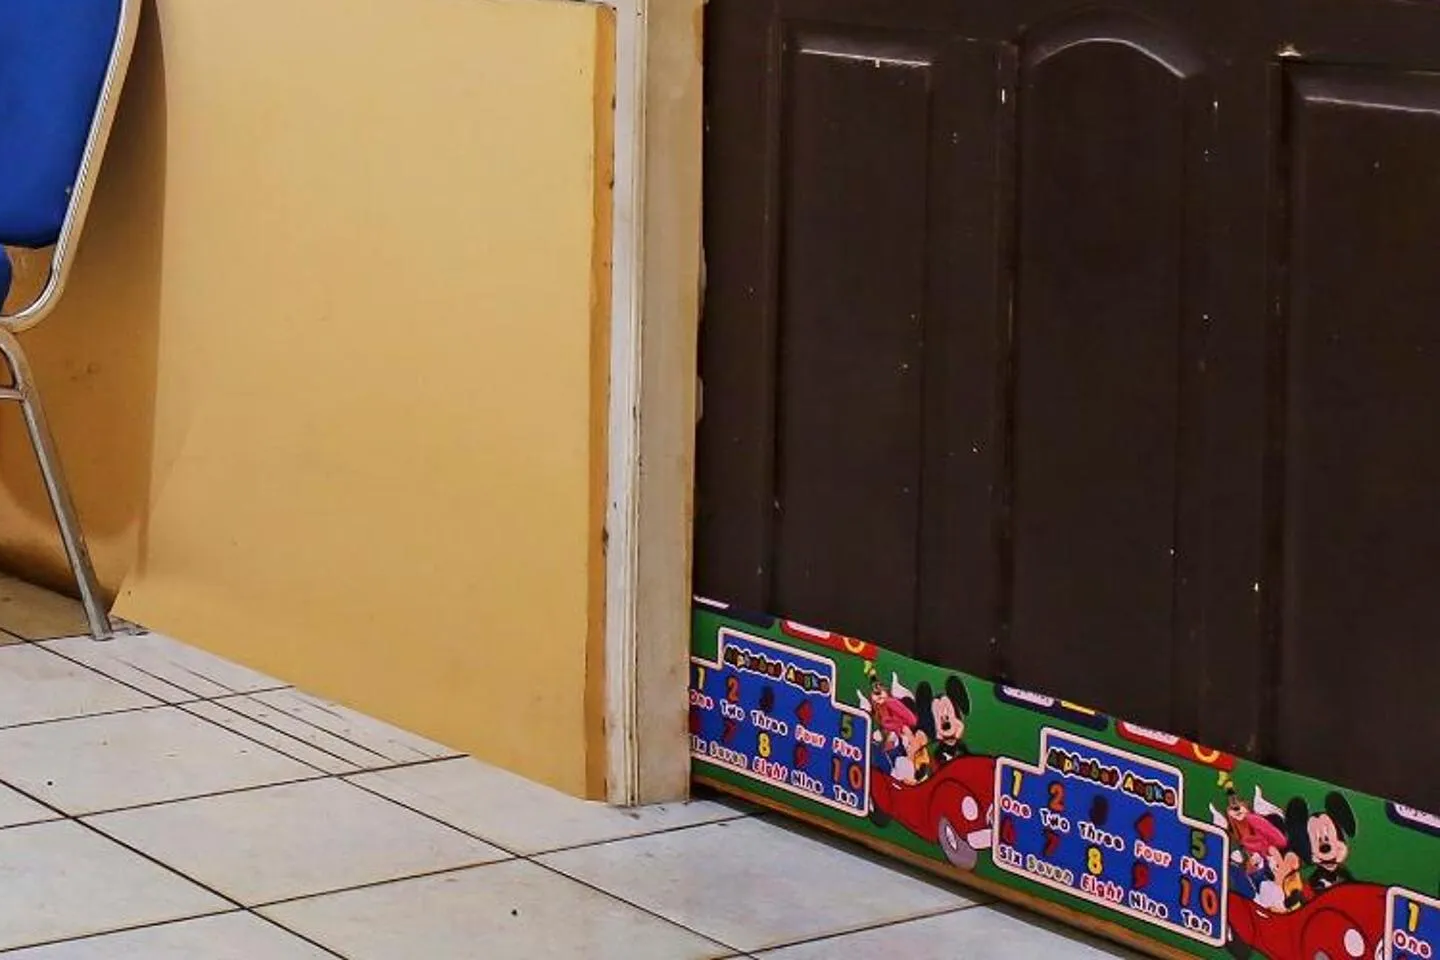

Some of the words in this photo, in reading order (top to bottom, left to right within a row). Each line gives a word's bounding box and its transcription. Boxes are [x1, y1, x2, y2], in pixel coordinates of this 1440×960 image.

[697, 667, 706, 690] 1
[727, 676, 739, 703] 2
[841, 714, 853, 740] 5
[720, 699, 745, 722] Two
[750, 710, 788, 736] Three
[832, 737, 862, 761] Five
[752, 756, 789, 782] Eight
[791, 770, 824, 794] Nine
[833, 784, 859, 808] Ten
[758, 732, 771, 758] 8
[833, 758, 863, 791] 10
[1000, 794, 1032, 819] One
[1040, 808, 1071, 833] Two
[1077, 821, 1125, 852] Three
[1134, 840, 1172, 868] Four
[1180, 856, 1218, 884] Five
[1012, 769, 1023, 798] 1
[1048, 782, 1065, 812] 2
[1191, 831, 1207, 861] 5
[998, 844, 1023, 867] Six
[1026, 853, 1074, 886] Seven
[1080, 873, 1124, 904] Eight
[1128, 890, 1168, 919] Nine
[1180, 908, 1213, 935] Ten
[1087, 846, 1103, 875] 8
[1181, 876, 1218, 916] 10
[1393, 929, 1431, 959] One
[1408, 901, 1421, 932] 1
